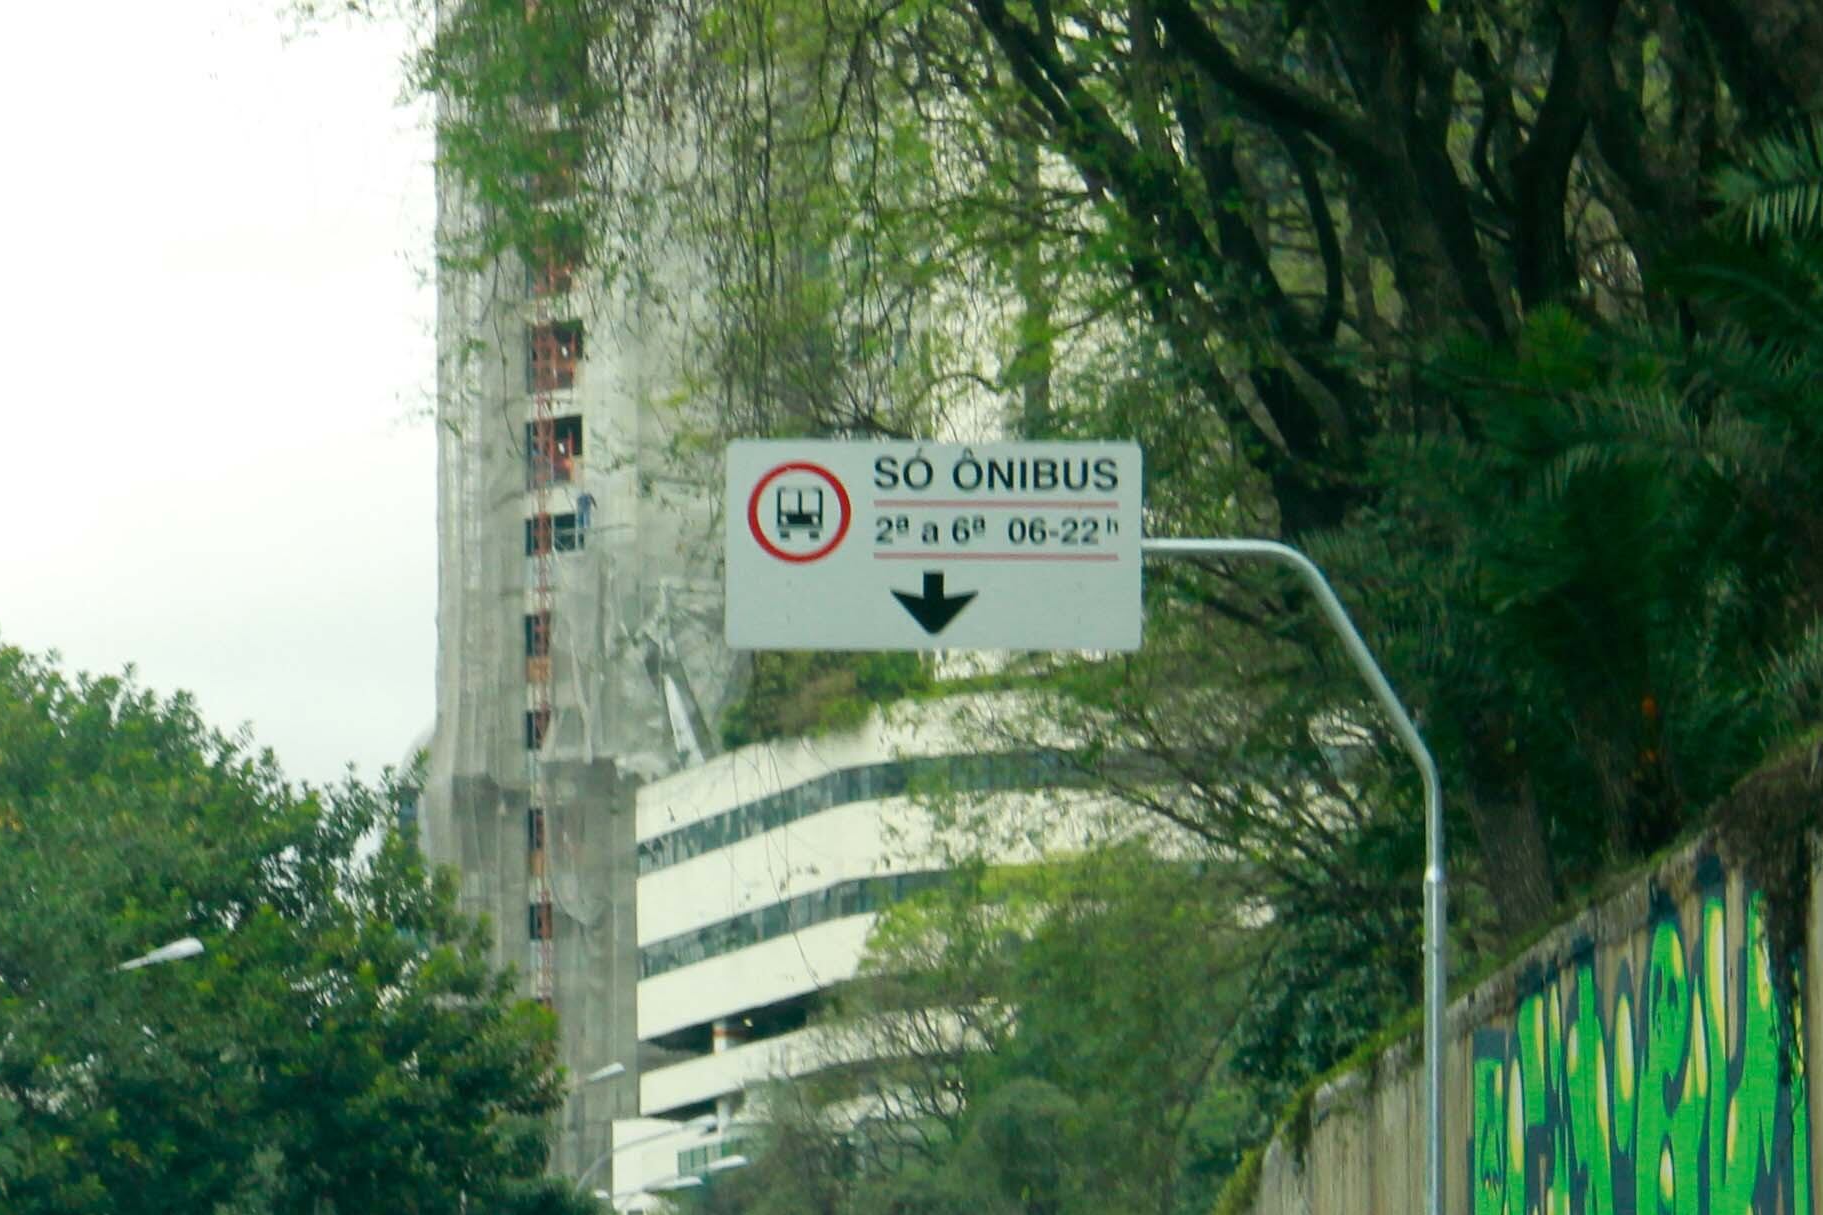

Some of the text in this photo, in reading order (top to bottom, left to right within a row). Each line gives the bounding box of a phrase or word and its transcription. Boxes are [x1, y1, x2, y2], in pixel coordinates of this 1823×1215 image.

[874, 447, 1119, 492] SÓ ÔNIBUS
[921, 524, 939, 545] a
